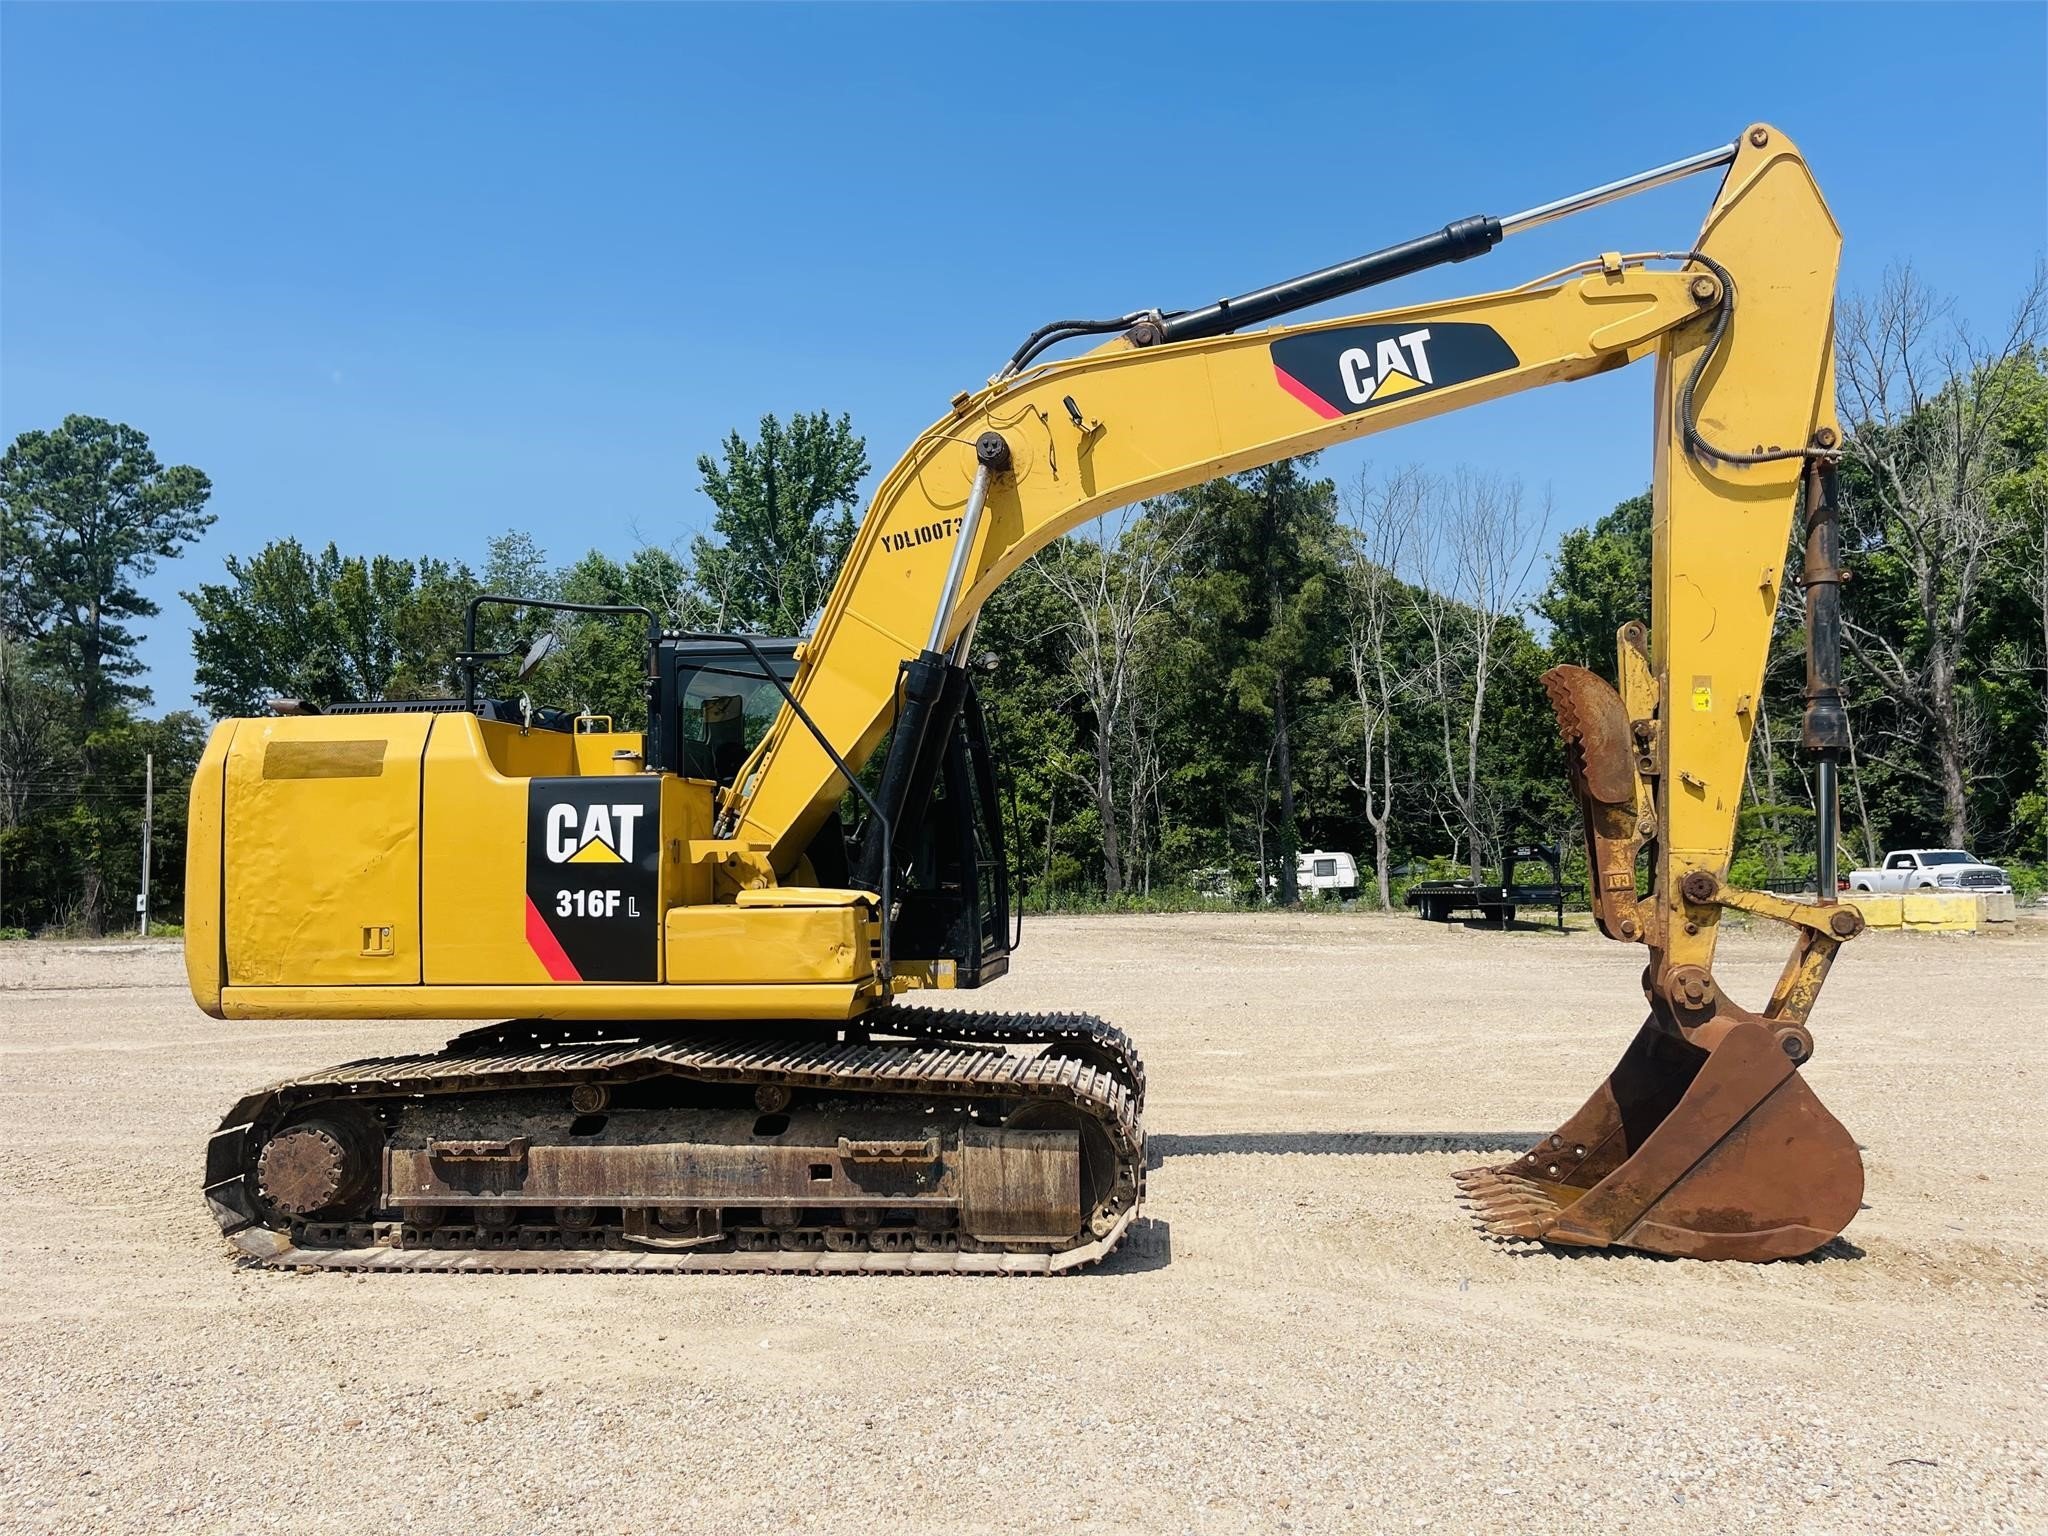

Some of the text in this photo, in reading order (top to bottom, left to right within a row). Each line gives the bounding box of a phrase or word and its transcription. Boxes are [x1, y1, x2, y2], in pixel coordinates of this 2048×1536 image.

[1339, 328, 1433, 405] CAT
[546, 803, 644, 864] CAT
[556, 889, 640, 917] 316F L
